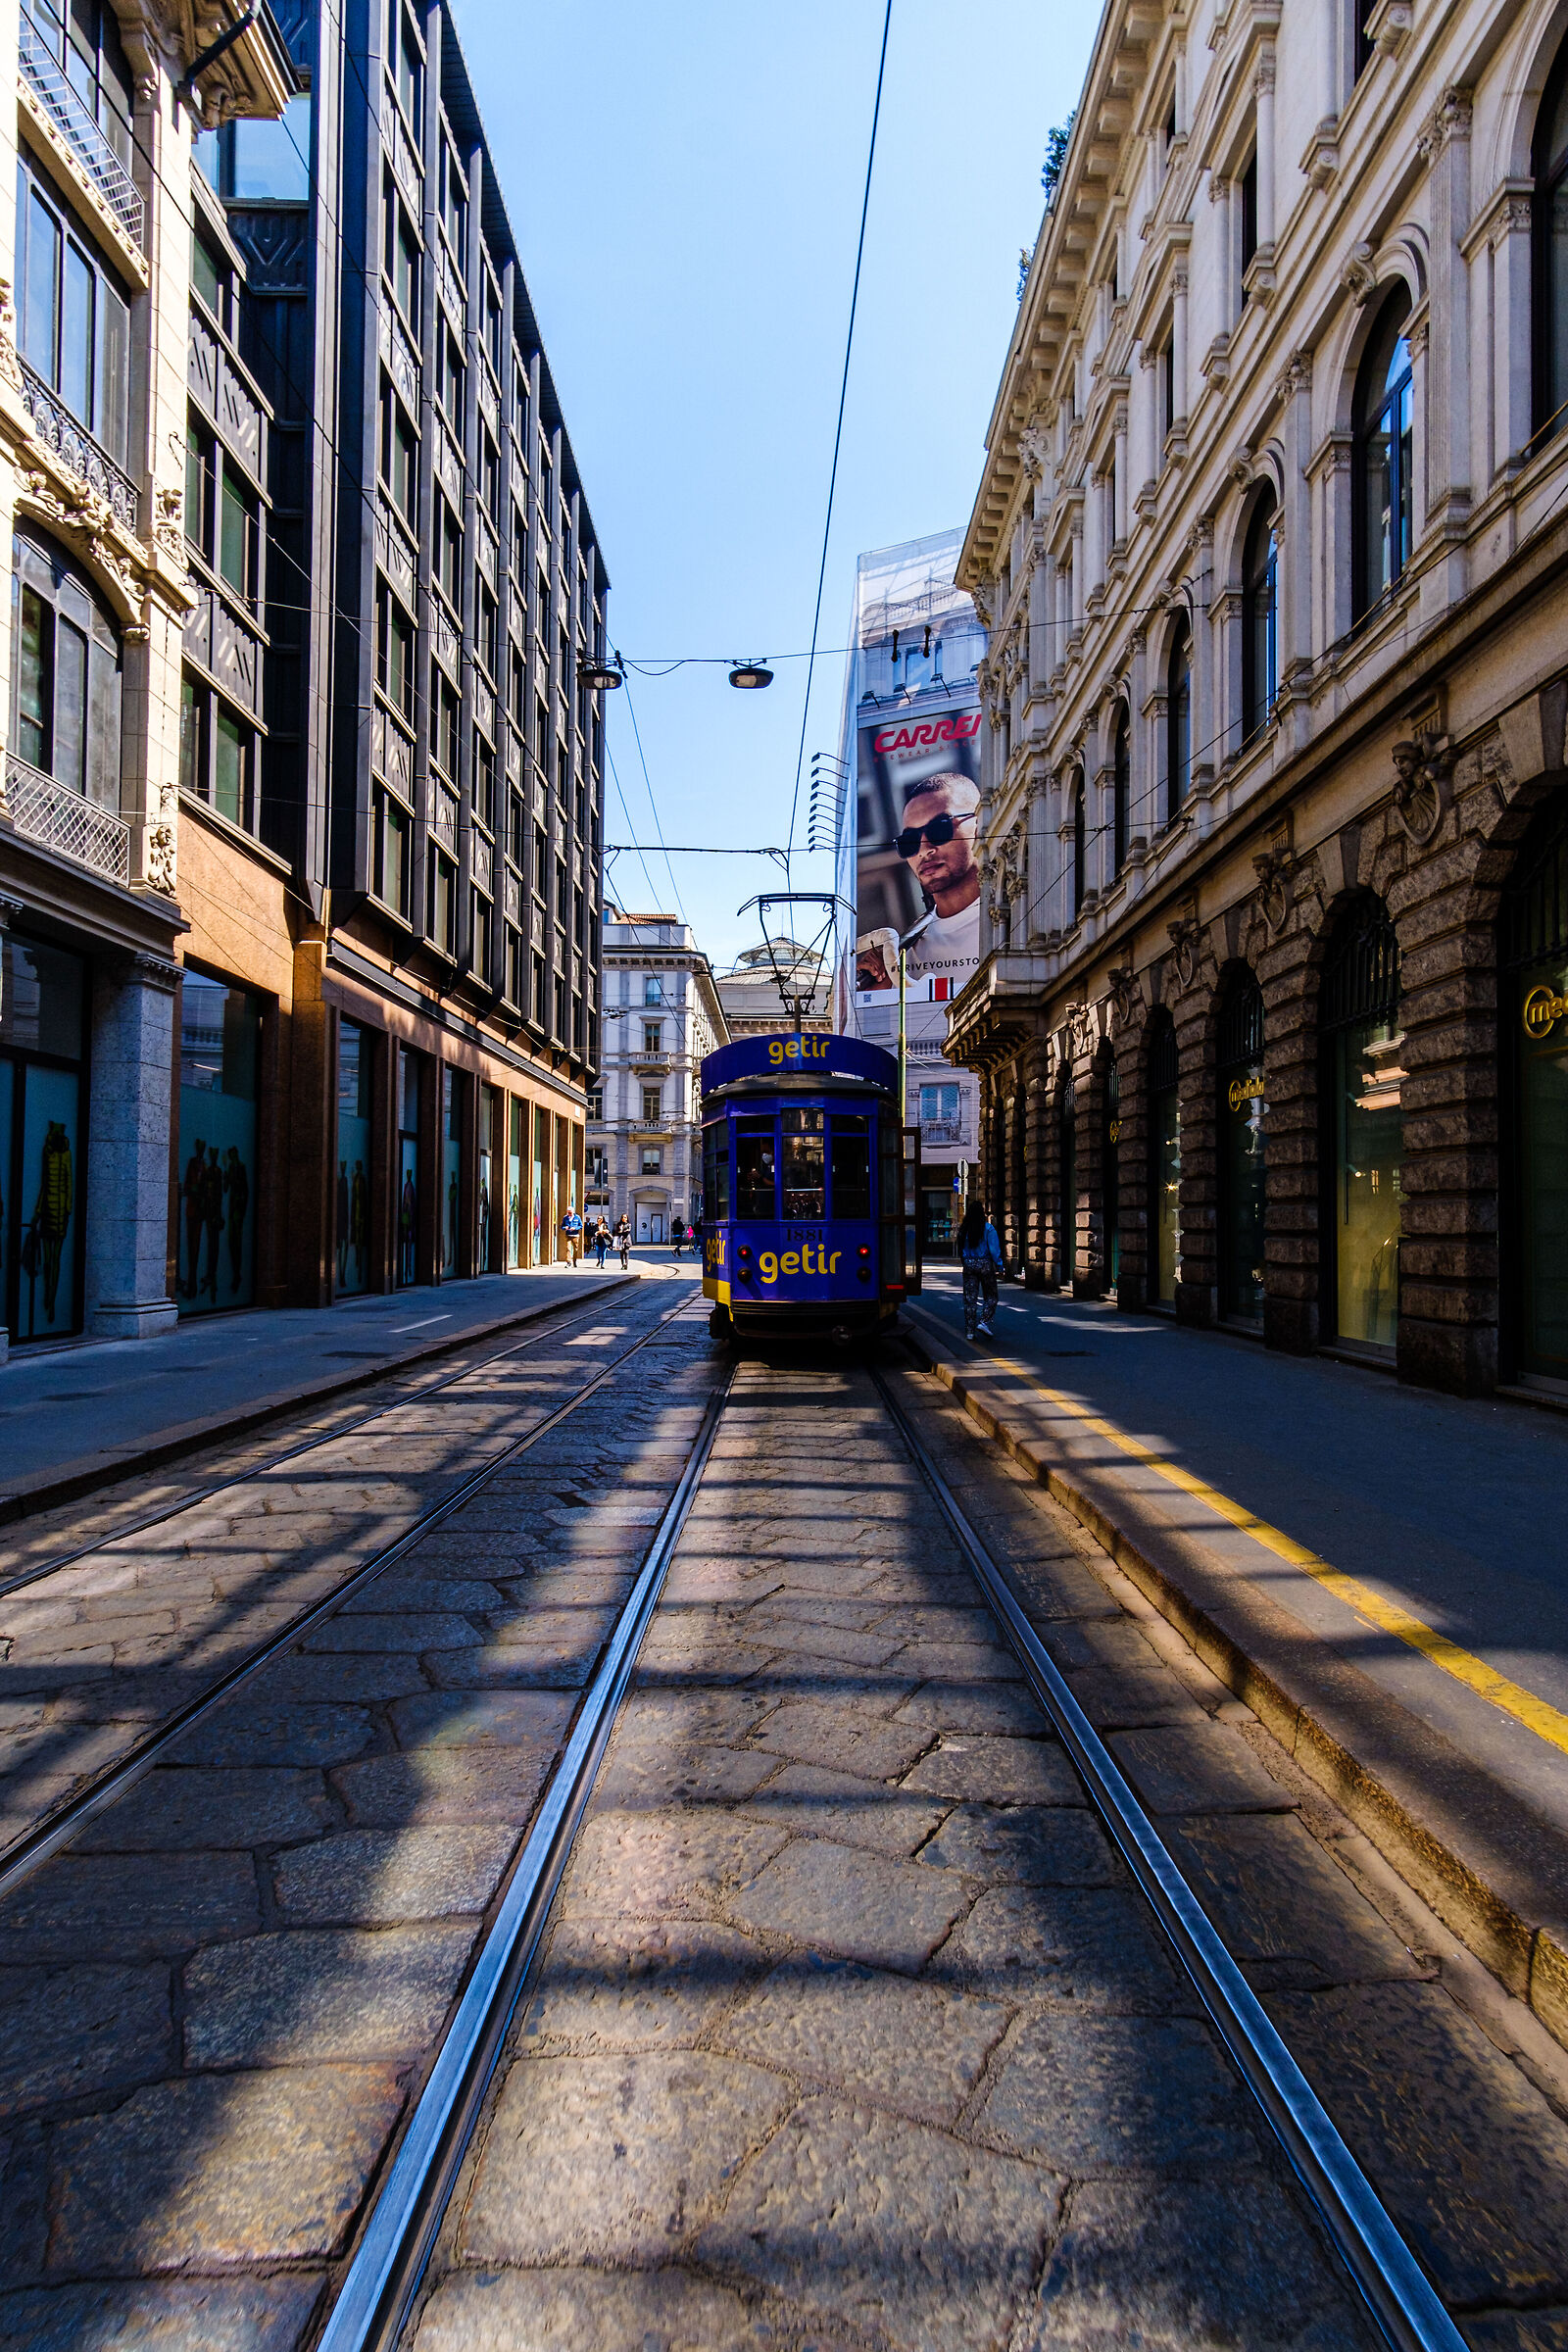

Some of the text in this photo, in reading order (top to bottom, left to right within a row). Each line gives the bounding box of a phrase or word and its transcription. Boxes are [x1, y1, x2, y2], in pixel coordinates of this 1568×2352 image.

[873, 748, 930, 763] EWEAR
[768, 1035, 830, 1064] getir
[786, 1229, 823, 1242] 1881
[706, 1230, 726, 1272] getir
[759, 1243, 842, 1284] getir
